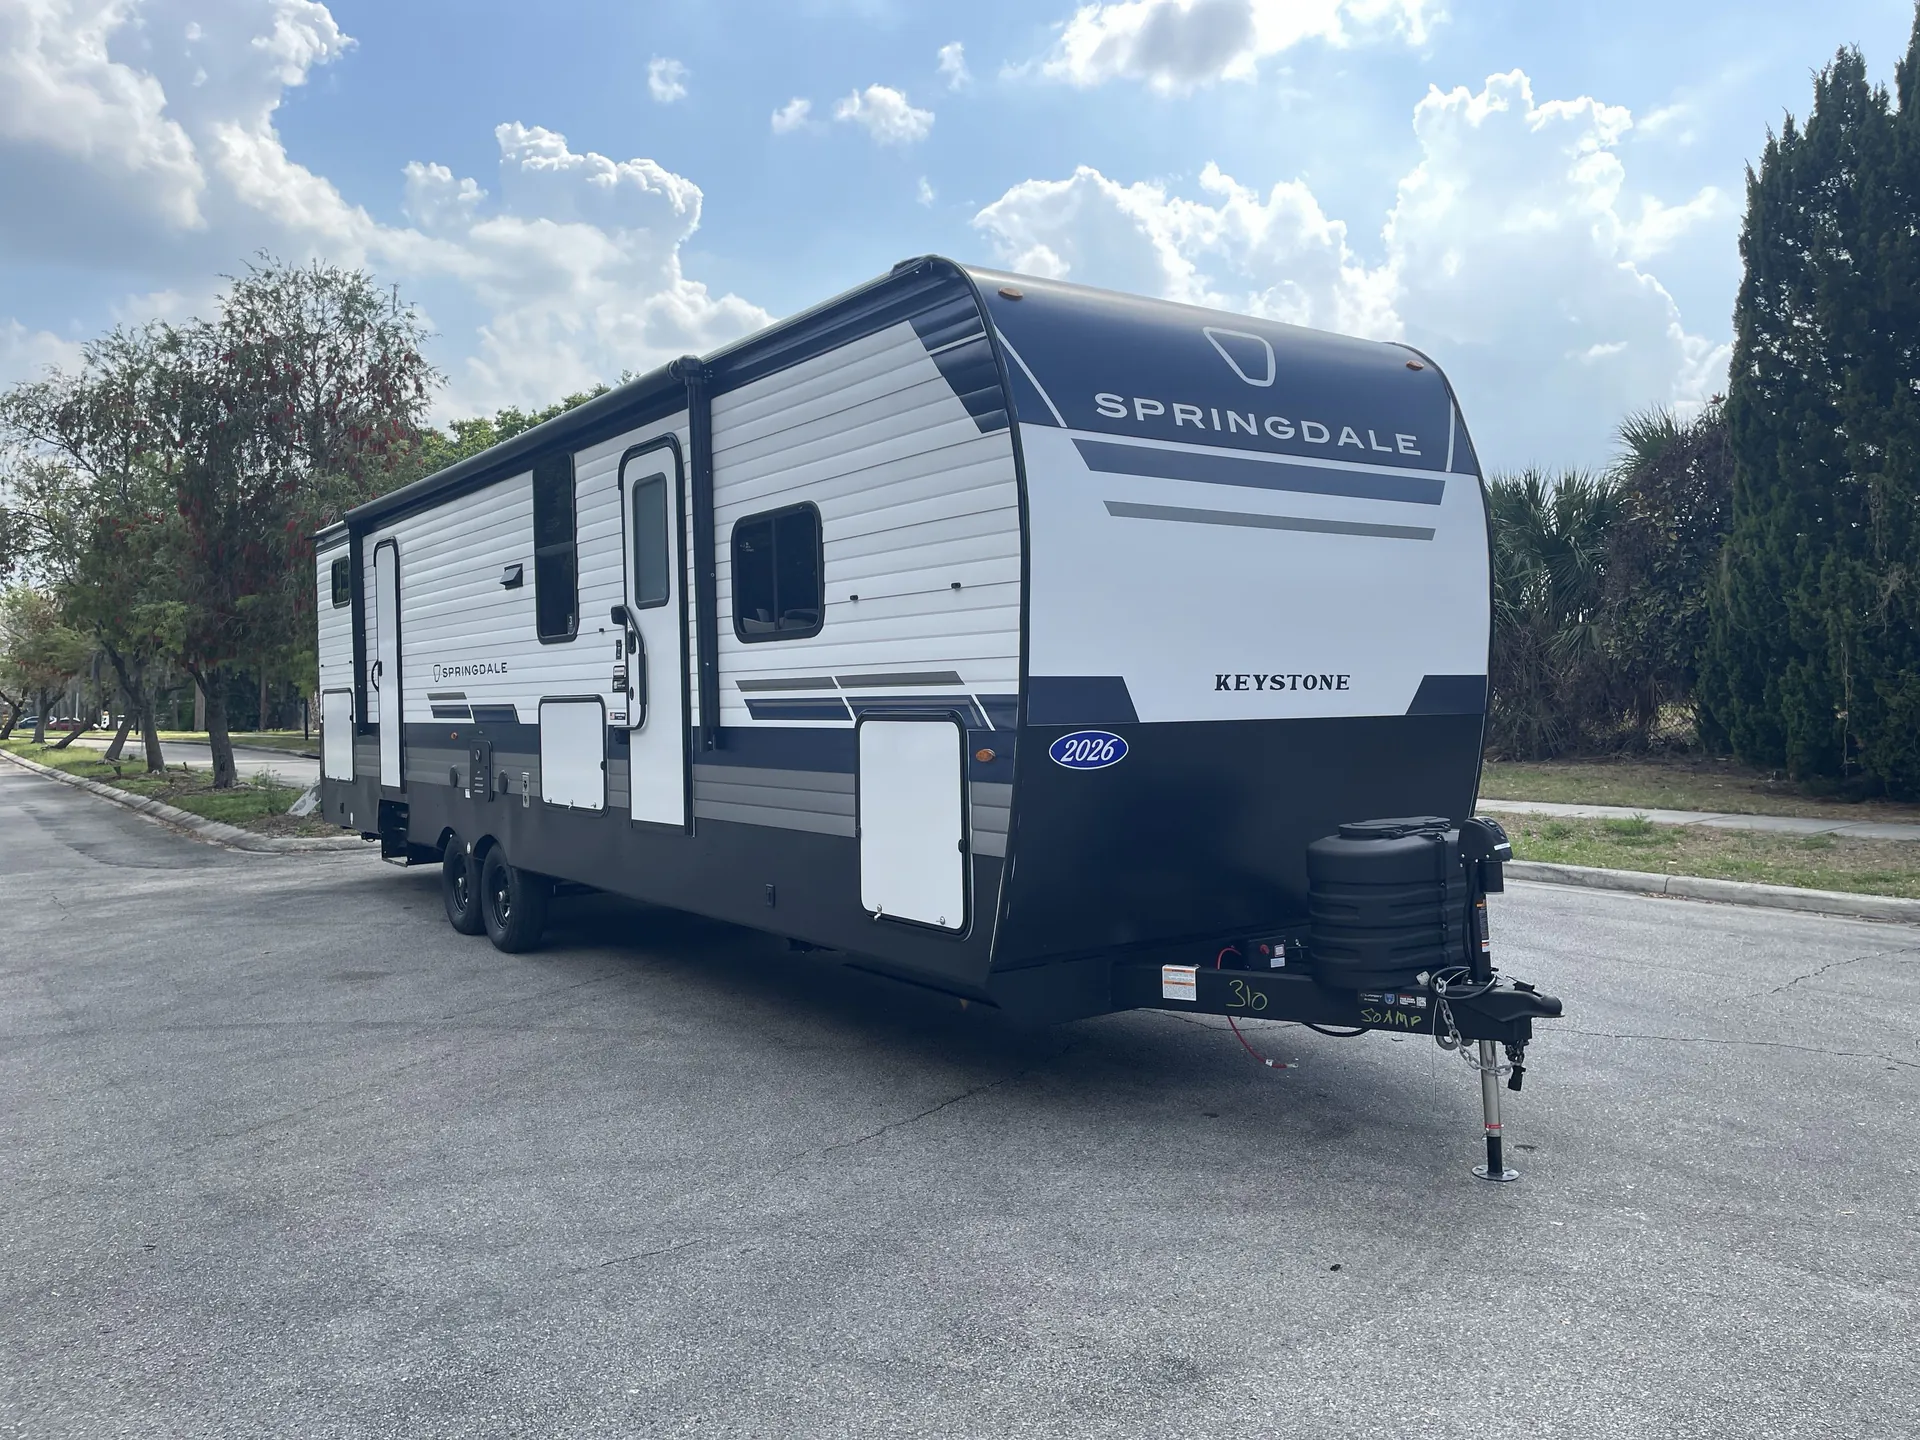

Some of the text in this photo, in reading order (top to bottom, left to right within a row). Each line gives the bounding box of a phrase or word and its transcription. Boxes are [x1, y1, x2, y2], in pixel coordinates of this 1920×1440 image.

[1094, 392, 1422, 456] SPRINGDALE
[442, 662, 508, 678] SPRINGDALE
[1213, 674, 1351, 691] KEYSTONE
[1060, 738, 1118, 762] 2026
[1226, 979, 1268, 1011] 310
